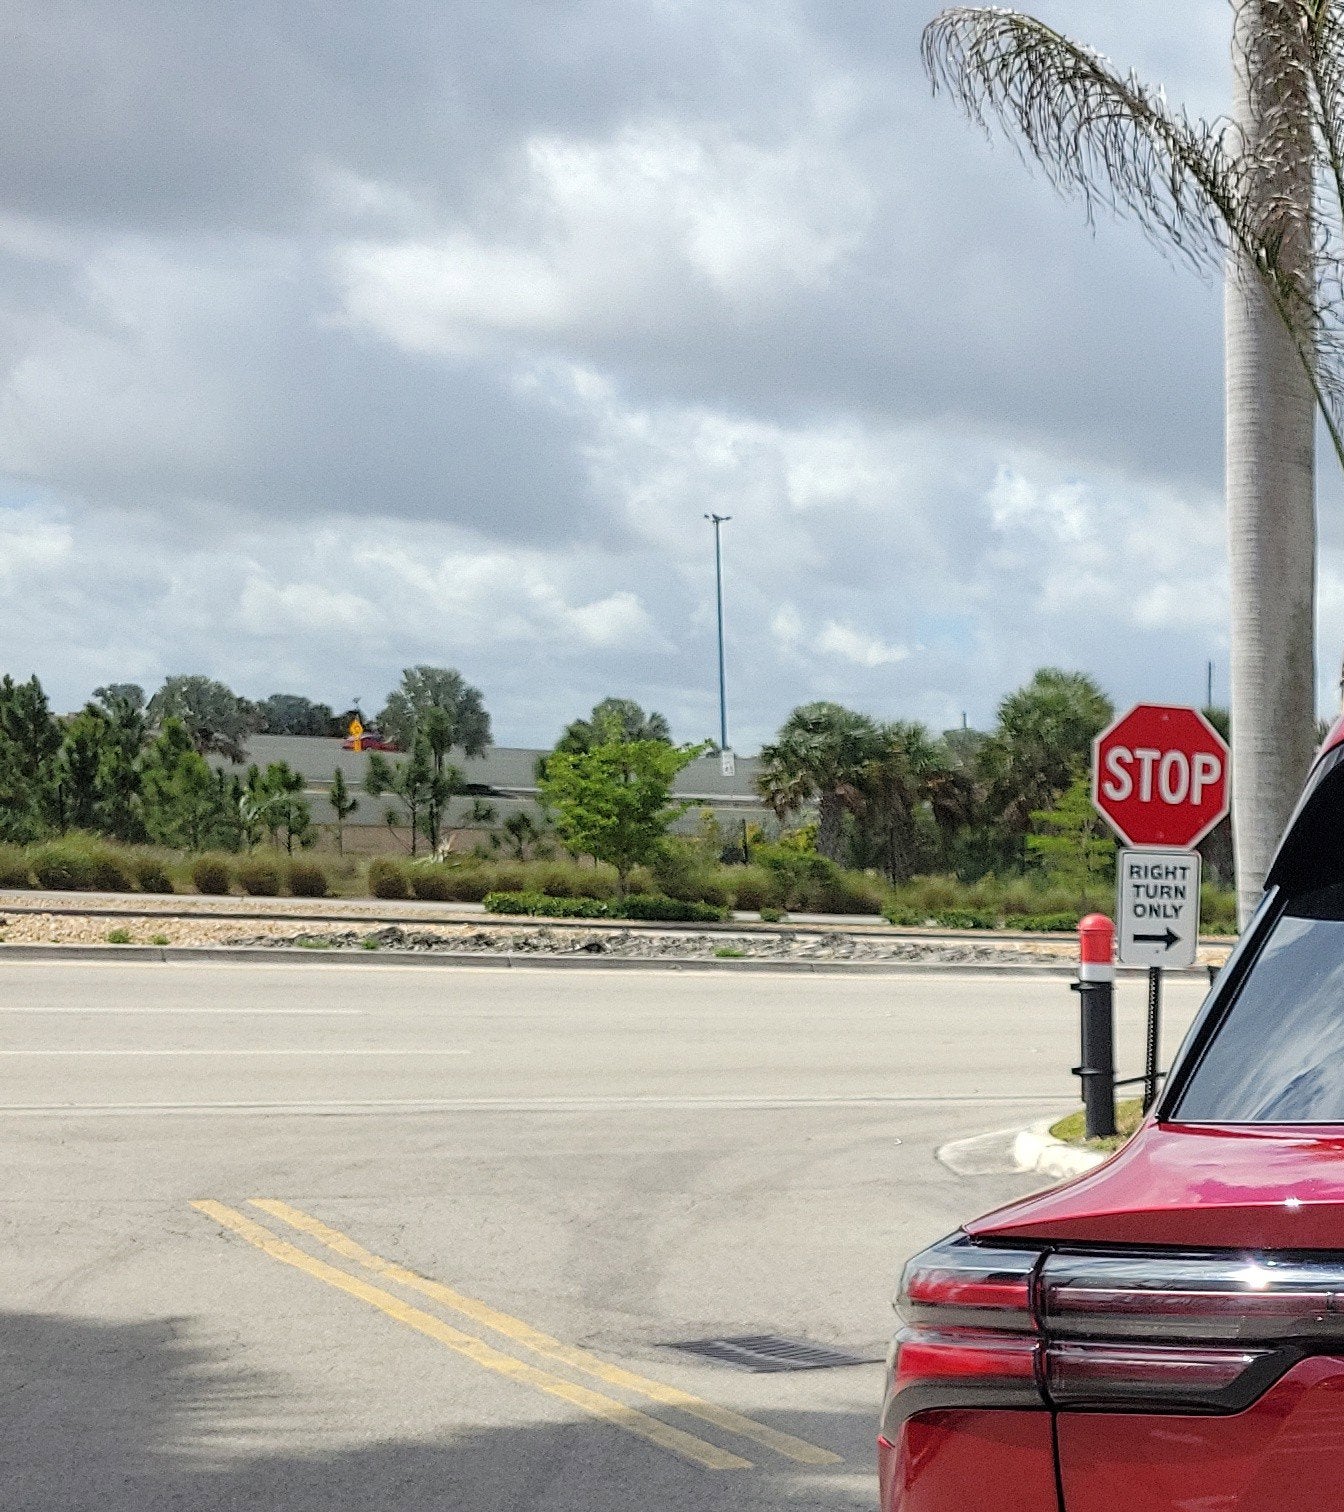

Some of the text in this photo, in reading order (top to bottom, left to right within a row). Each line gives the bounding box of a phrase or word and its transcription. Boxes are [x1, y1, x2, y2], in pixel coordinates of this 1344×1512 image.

[1102, 746, 1222, 806] STOP
[1130, 865, 1190, 881] RIGHT
[1133, 884, 1187, 899] TURN
[1133, 903, 1184, 919] ONLY
